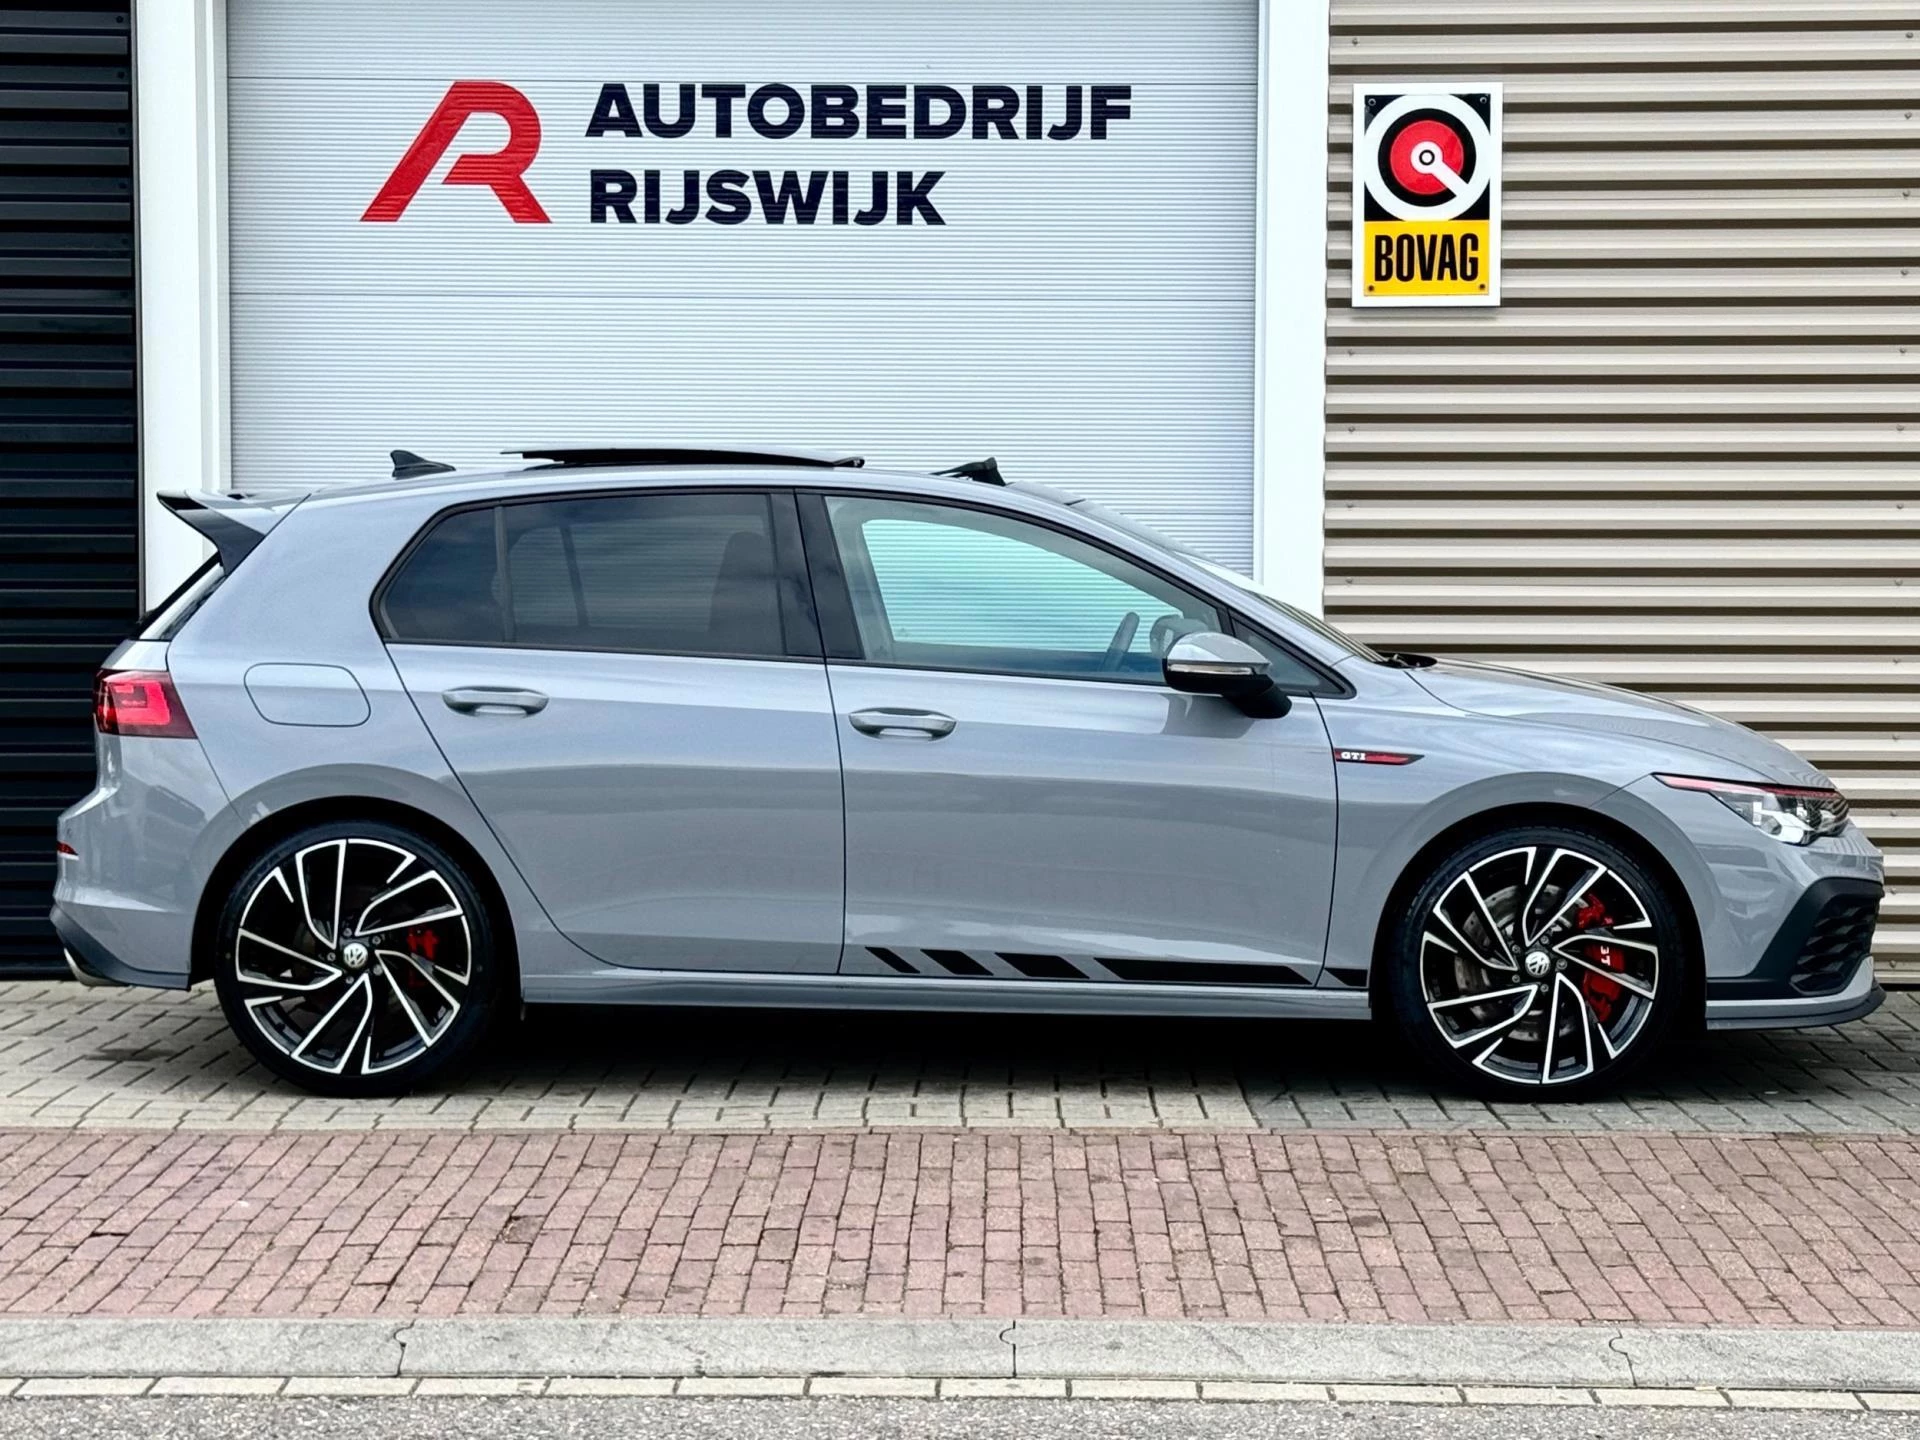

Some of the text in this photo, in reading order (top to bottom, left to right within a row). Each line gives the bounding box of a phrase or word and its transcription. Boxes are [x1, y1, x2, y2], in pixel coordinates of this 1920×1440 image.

[585, 83, 1132, 141] AUTOBEDRIJF
[590, 169, 947, 226] RIJSWIJK
[1374, 232, 1479, 282] BOVAG
[1340, 751, 1367, 761] GTI
